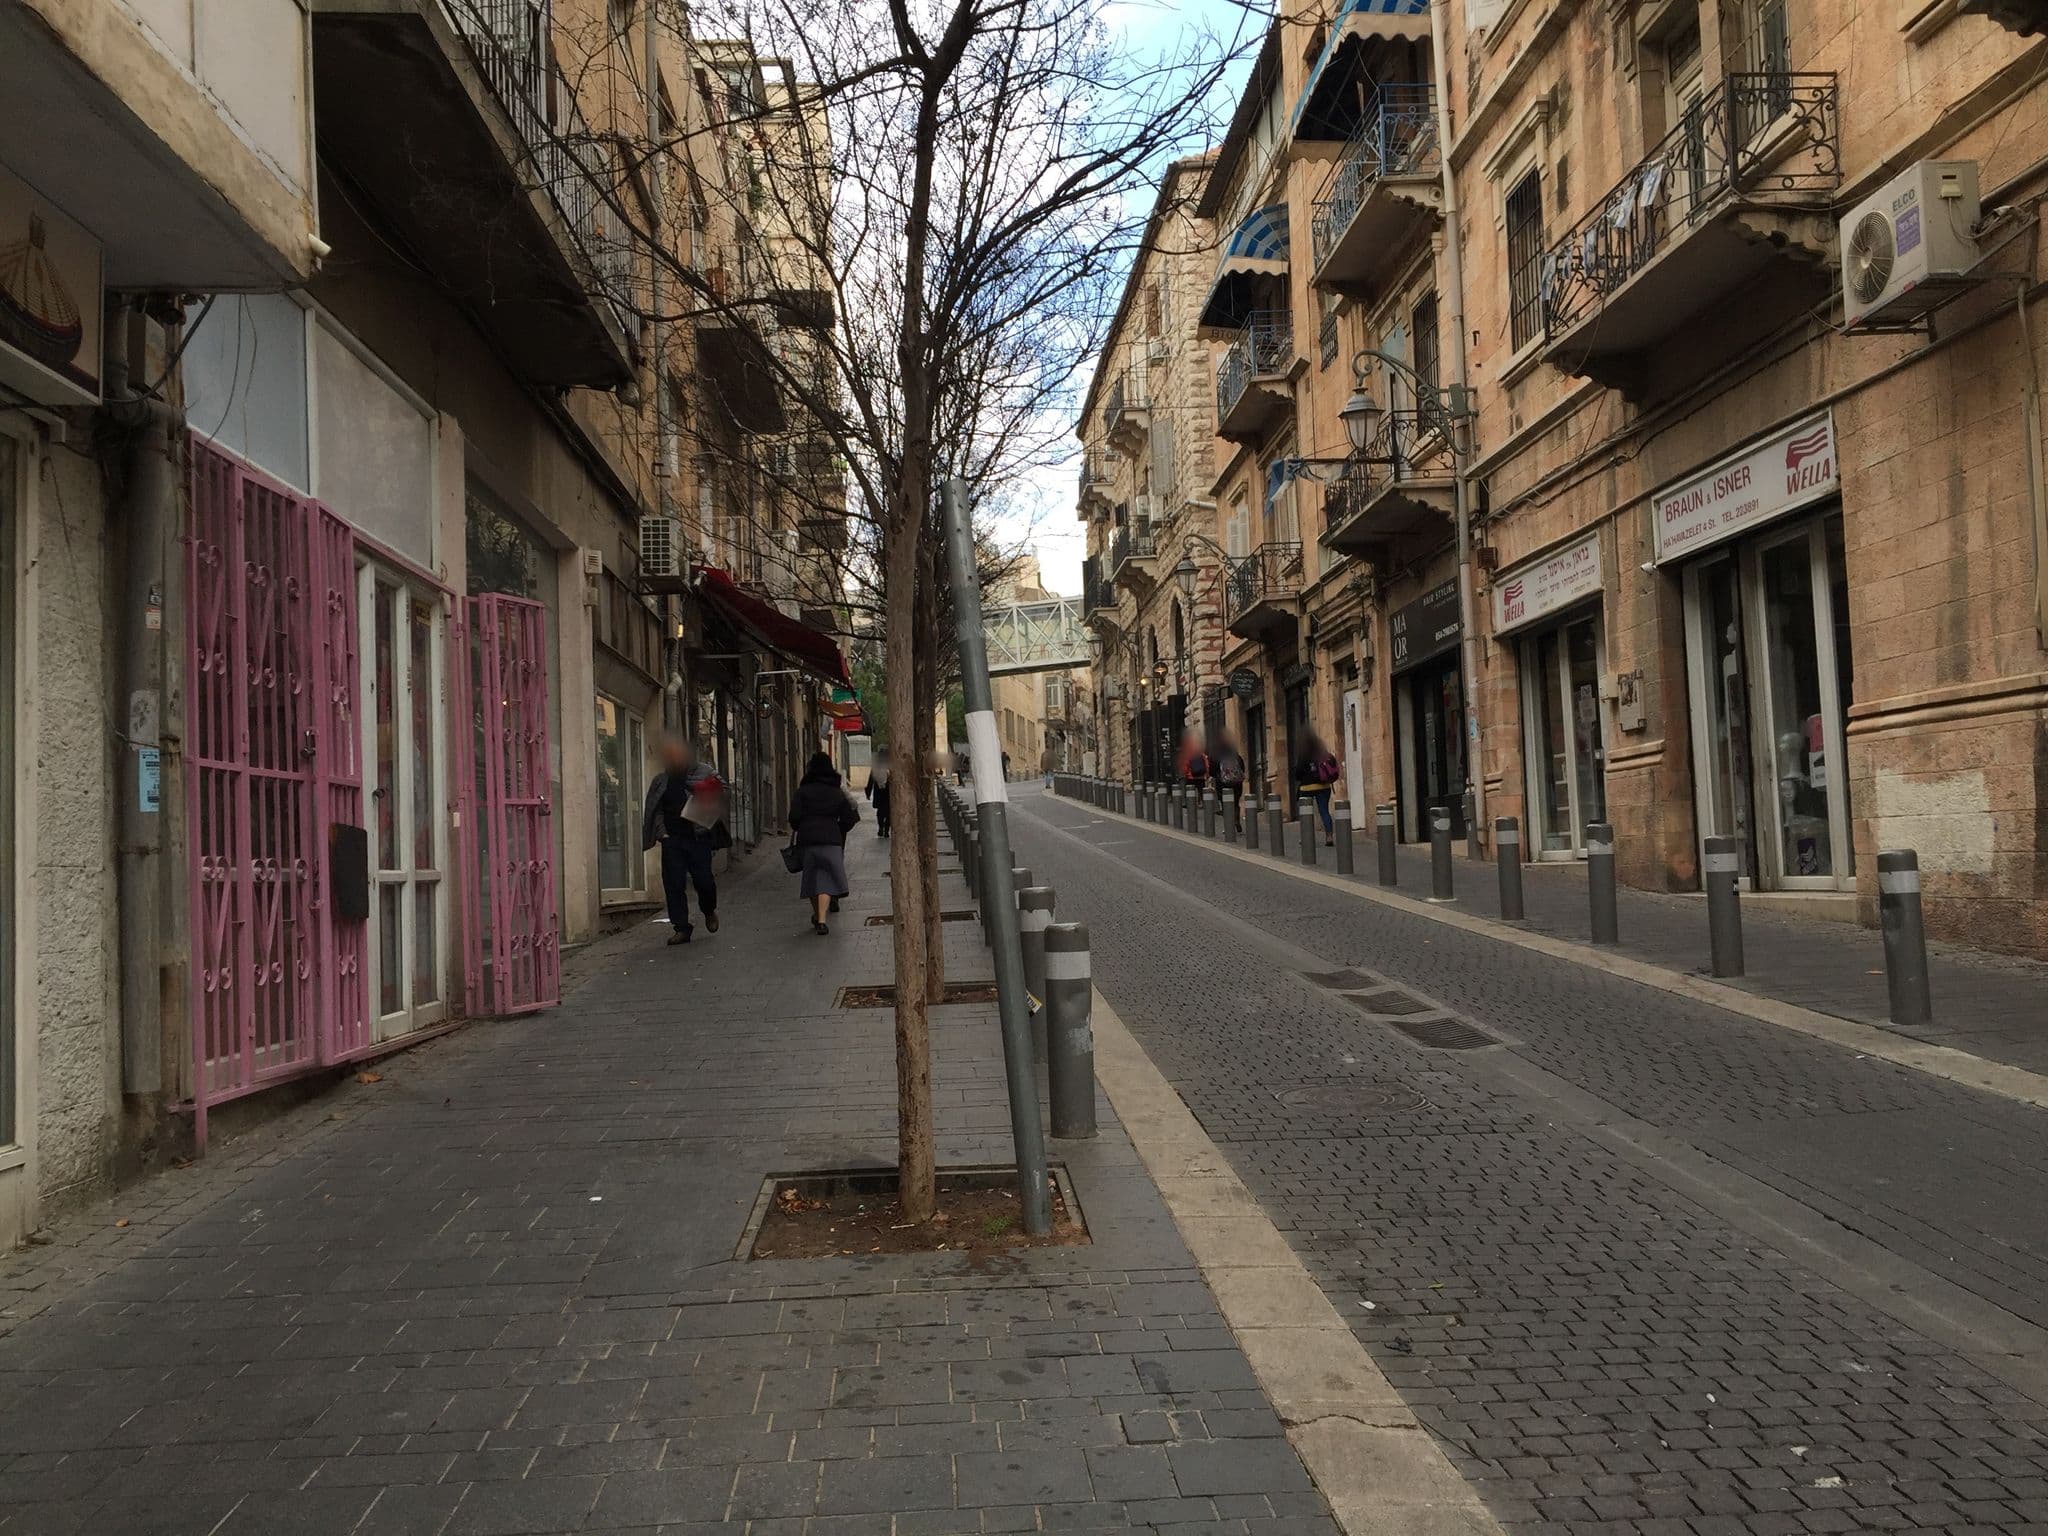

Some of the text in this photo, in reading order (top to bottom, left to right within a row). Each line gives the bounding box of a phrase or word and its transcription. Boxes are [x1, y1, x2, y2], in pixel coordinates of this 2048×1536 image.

[1892, 188, 1915, 211] ELCO
[1787, 458, 1830, 495] WELLA
[1665, 466, 1751, 522] BRAUN & ISNER
[1394, 612, 1407, 636] MA
[1504, 602, 1524, 623] WELLA
[1394, 637, 1408, 659] OR
